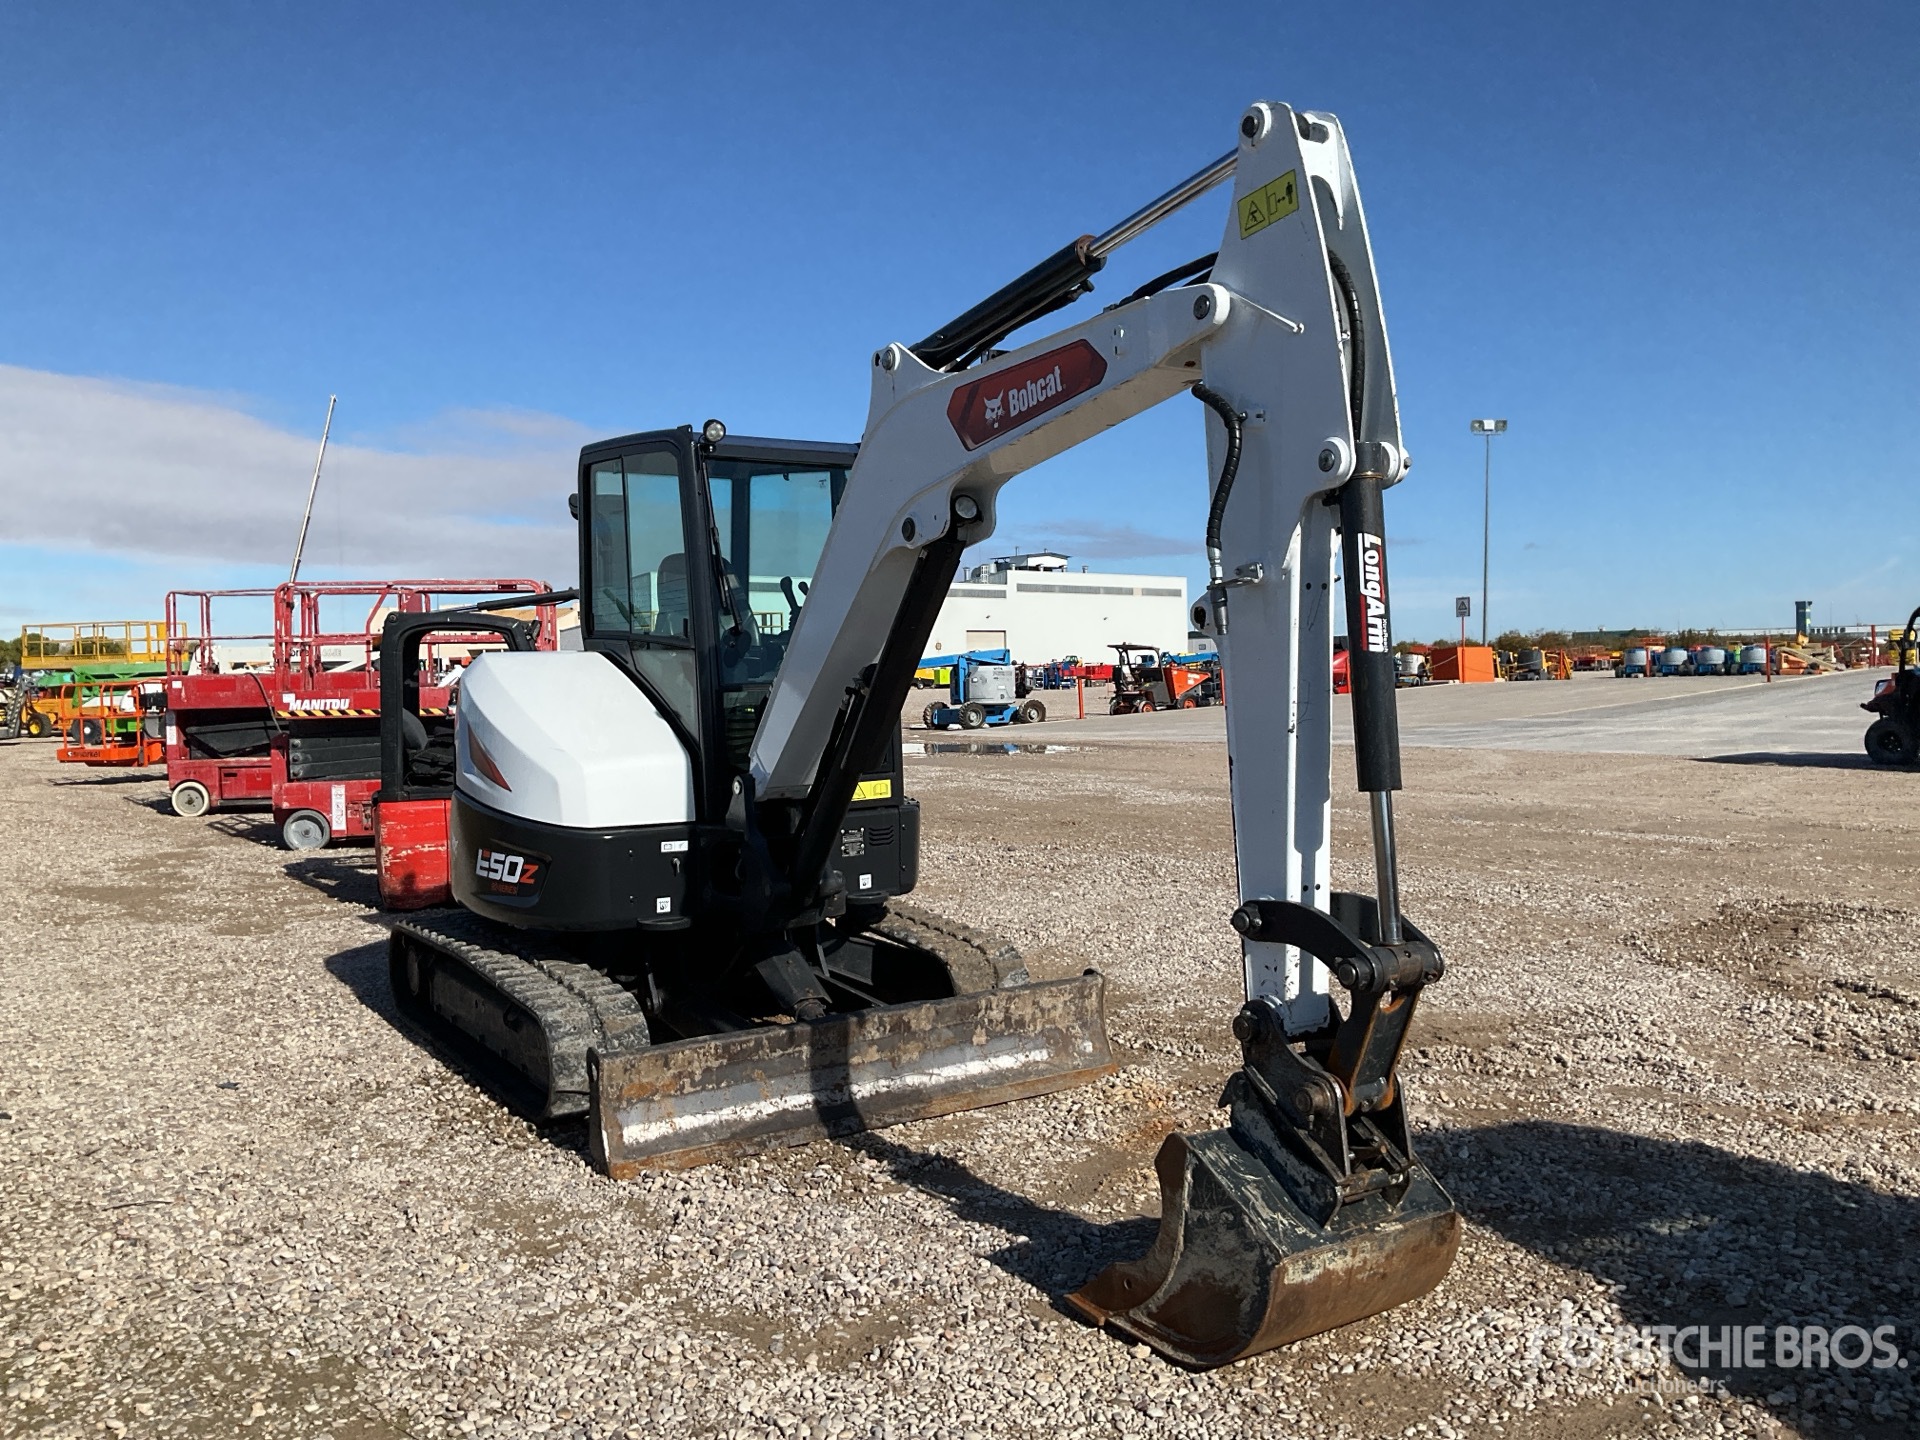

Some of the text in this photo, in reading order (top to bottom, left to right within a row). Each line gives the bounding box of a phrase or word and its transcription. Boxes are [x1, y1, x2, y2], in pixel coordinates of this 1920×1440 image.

[1009, 365, 1062, 417] Bobcat
[1358, 532, 1386, 653] LongArm
[289, 698, 350, 711] MANITOU
